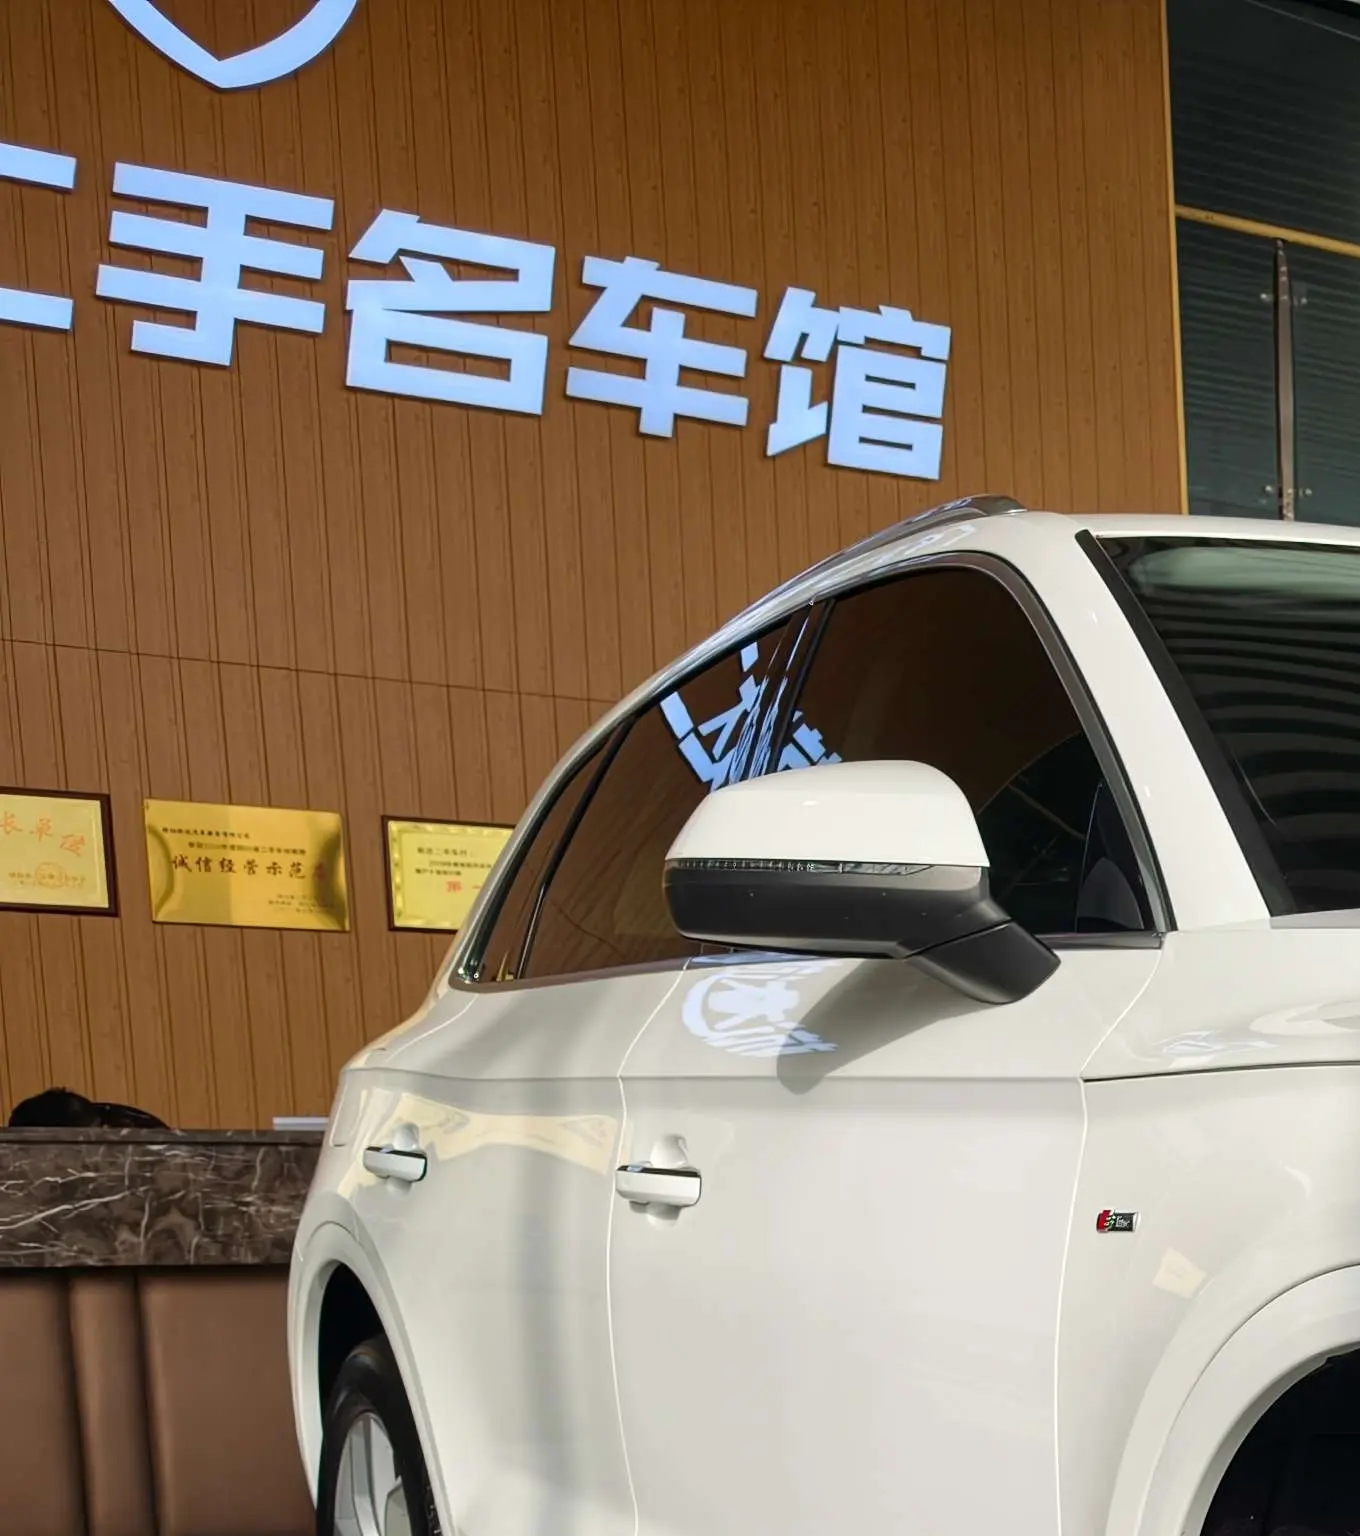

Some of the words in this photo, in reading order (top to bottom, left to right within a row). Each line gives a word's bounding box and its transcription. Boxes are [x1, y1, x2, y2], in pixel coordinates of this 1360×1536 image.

[172, 854, 327, 882] 诚信经营示范
